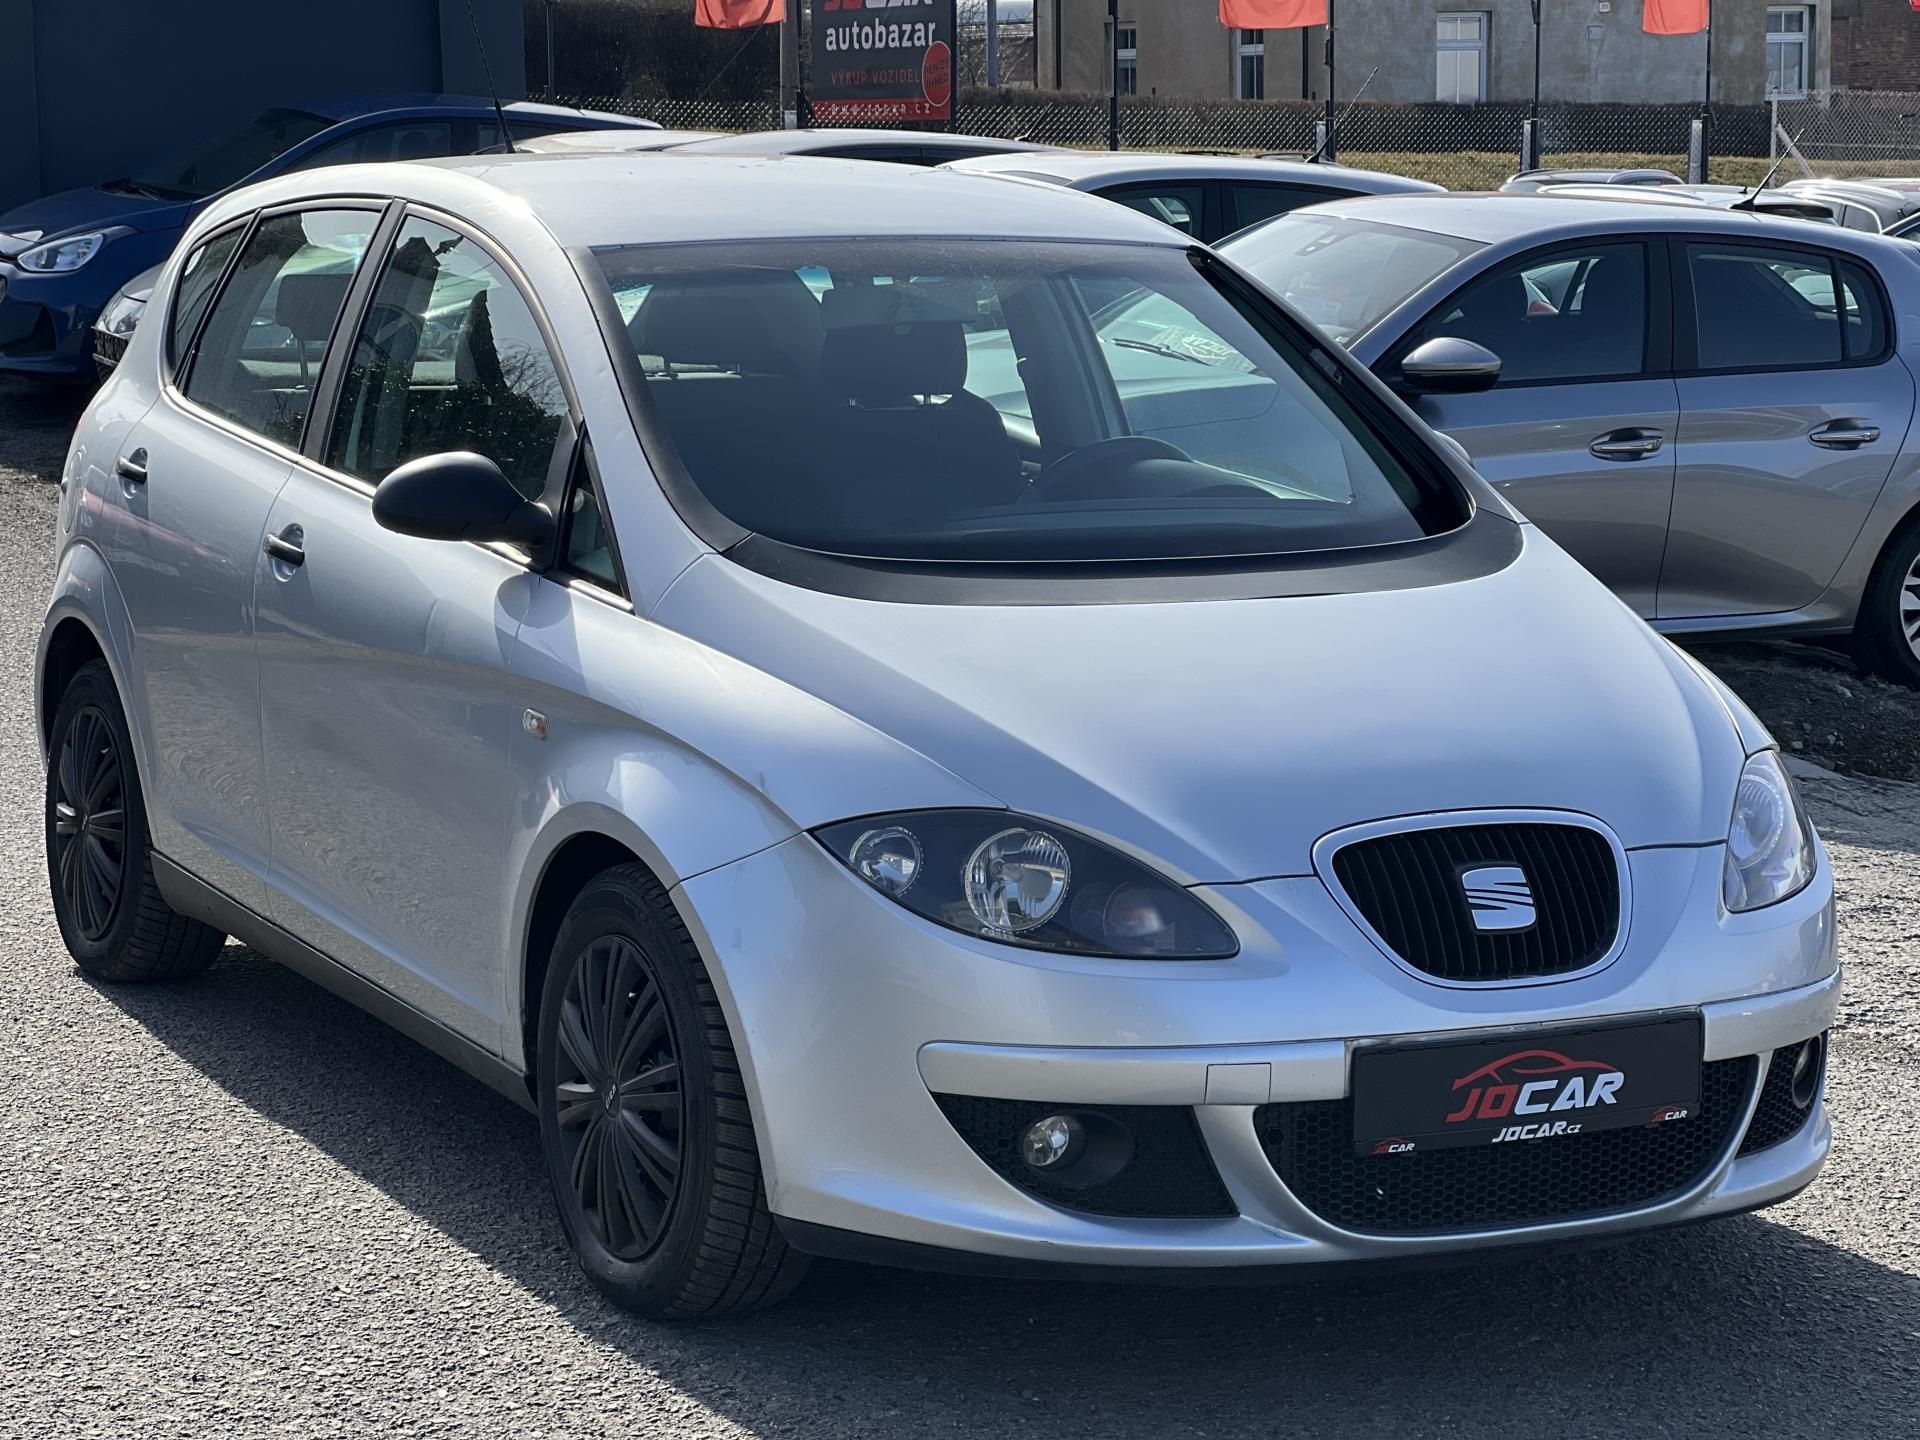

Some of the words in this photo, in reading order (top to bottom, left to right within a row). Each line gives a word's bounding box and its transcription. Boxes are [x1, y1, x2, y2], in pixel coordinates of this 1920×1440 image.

[825, 18, 936, 51] autobazar
[831, 69, 867, 86] VÝKUP
[872, 68, 920, 84] VOZIDEL
[1446, 1071, 1625, 1123] JOCAR
